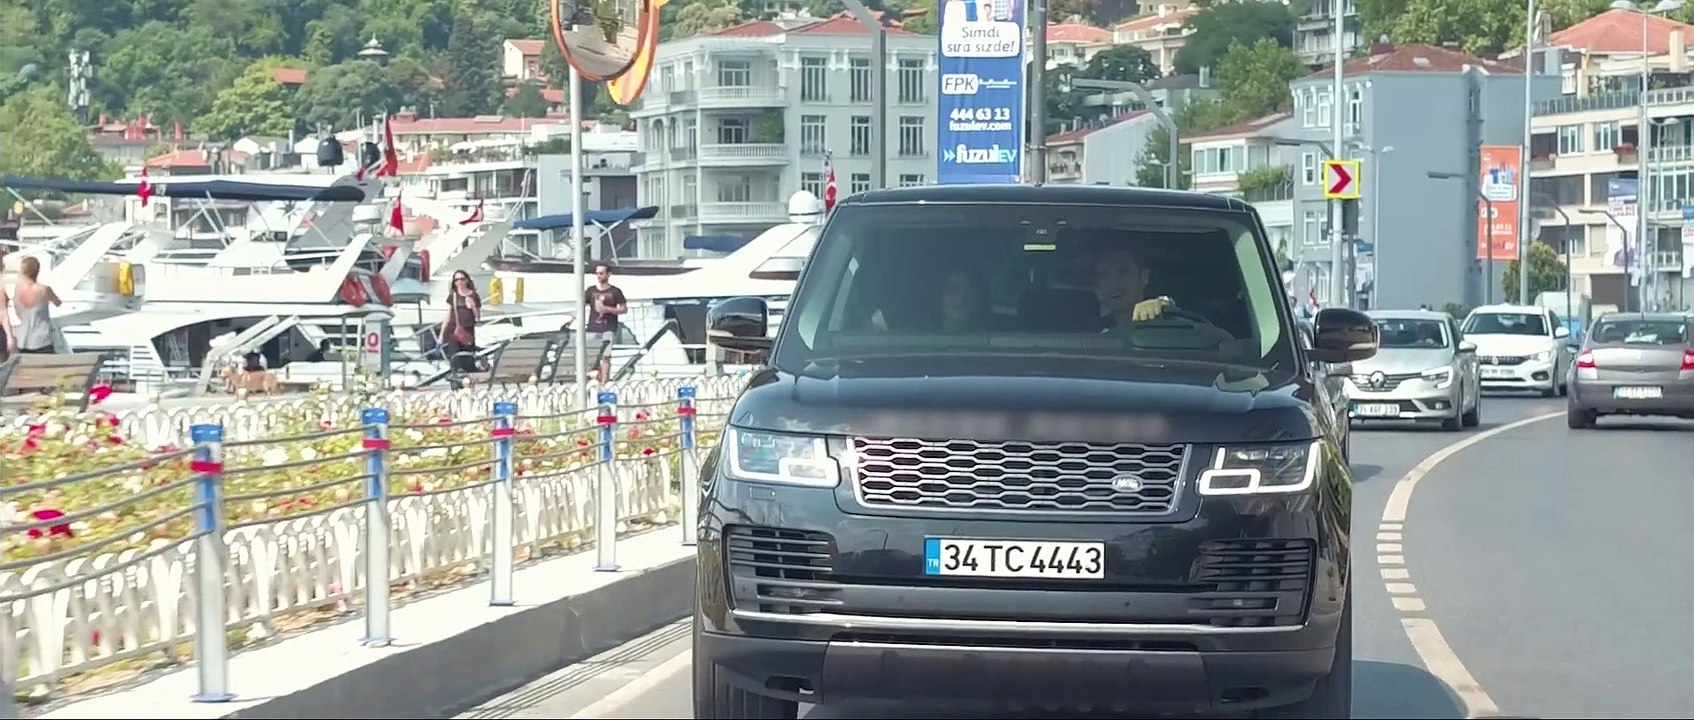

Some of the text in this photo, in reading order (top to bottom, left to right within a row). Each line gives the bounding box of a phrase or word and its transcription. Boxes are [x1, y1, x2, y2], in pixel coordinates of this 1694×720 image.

[945, 77, 975, 91] FPK
[950, 108, 1010, 120] 444 63 13
[956, 144, 1017, 164] fuzulEV
[927, 559, 939, 568] TR
[944, 544, 1101, 574] 34 TC 4443
